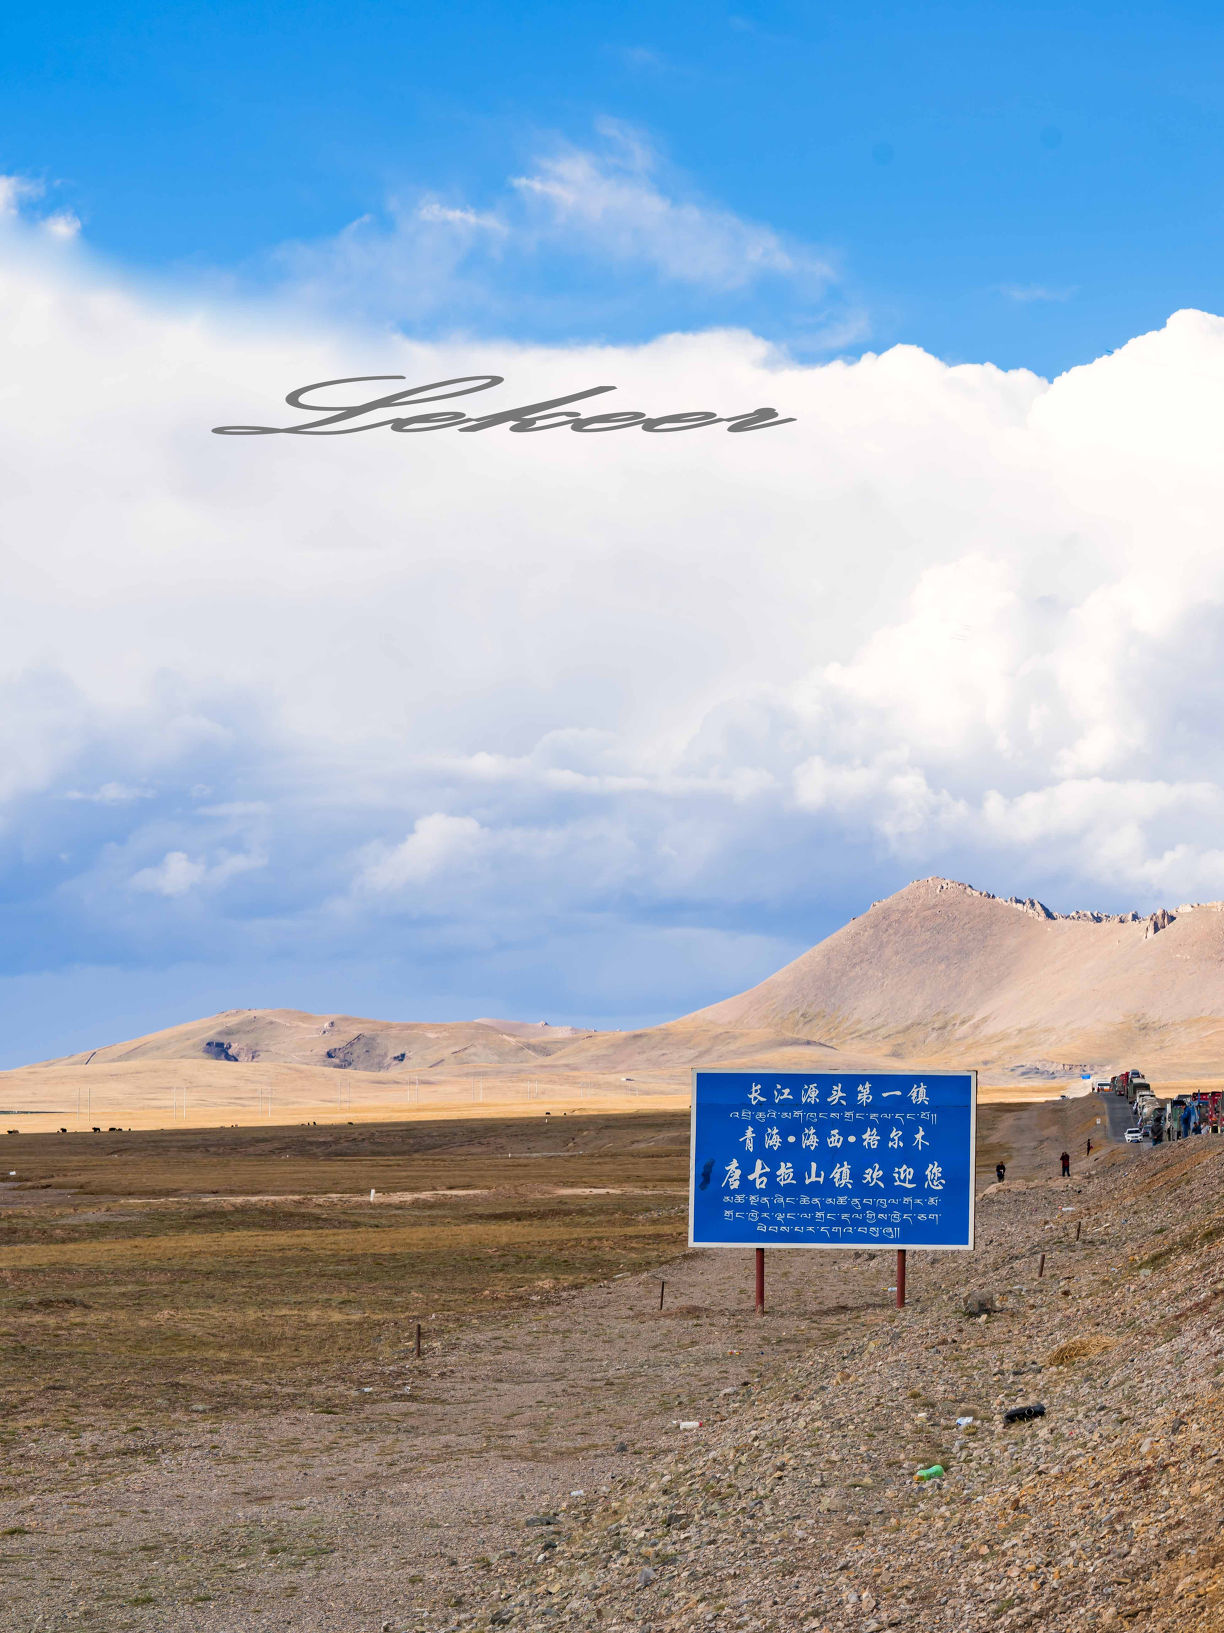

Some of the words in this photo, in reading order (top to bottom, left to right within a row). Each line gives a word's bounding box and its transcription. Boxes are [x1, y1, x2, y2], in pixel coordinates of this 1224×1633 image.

[747, 1081, 930, 1106] 长江源头第一镇
[721, 1158, 946, 1190] 唐古拉山镇欢迎您
